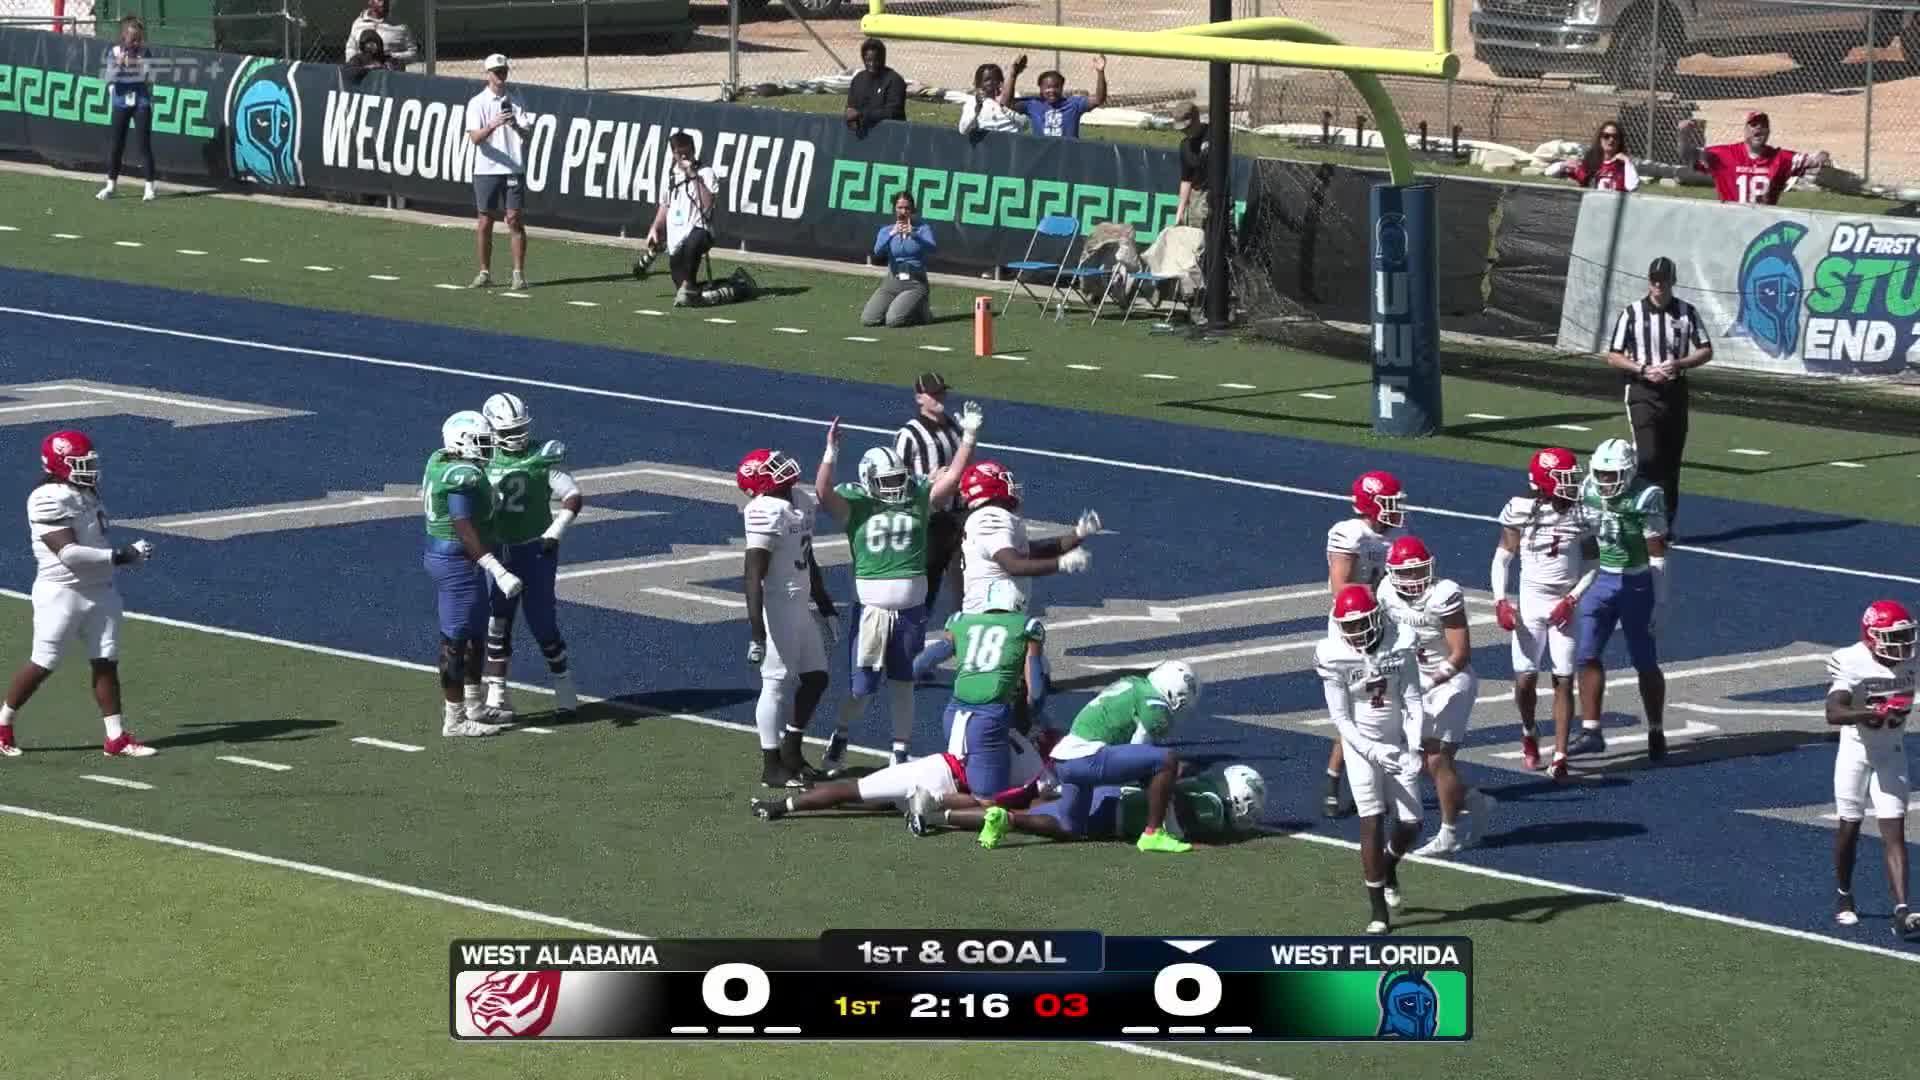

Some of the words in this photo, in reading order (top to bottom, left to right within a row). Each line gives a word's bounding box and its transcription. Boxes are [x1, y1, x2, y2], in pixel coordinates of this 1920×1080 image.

[322, 89, 482, 186] WELCOM
[710, 131, 815, 220] FIELD
[1830, 225, 1872, 253] D1
[1865, 236, 1916, 256] FIRST
[1804, 317, 1897, 363] END
[865, 512, 912, 553] 60
[964, 624, 1008, 672] 18
